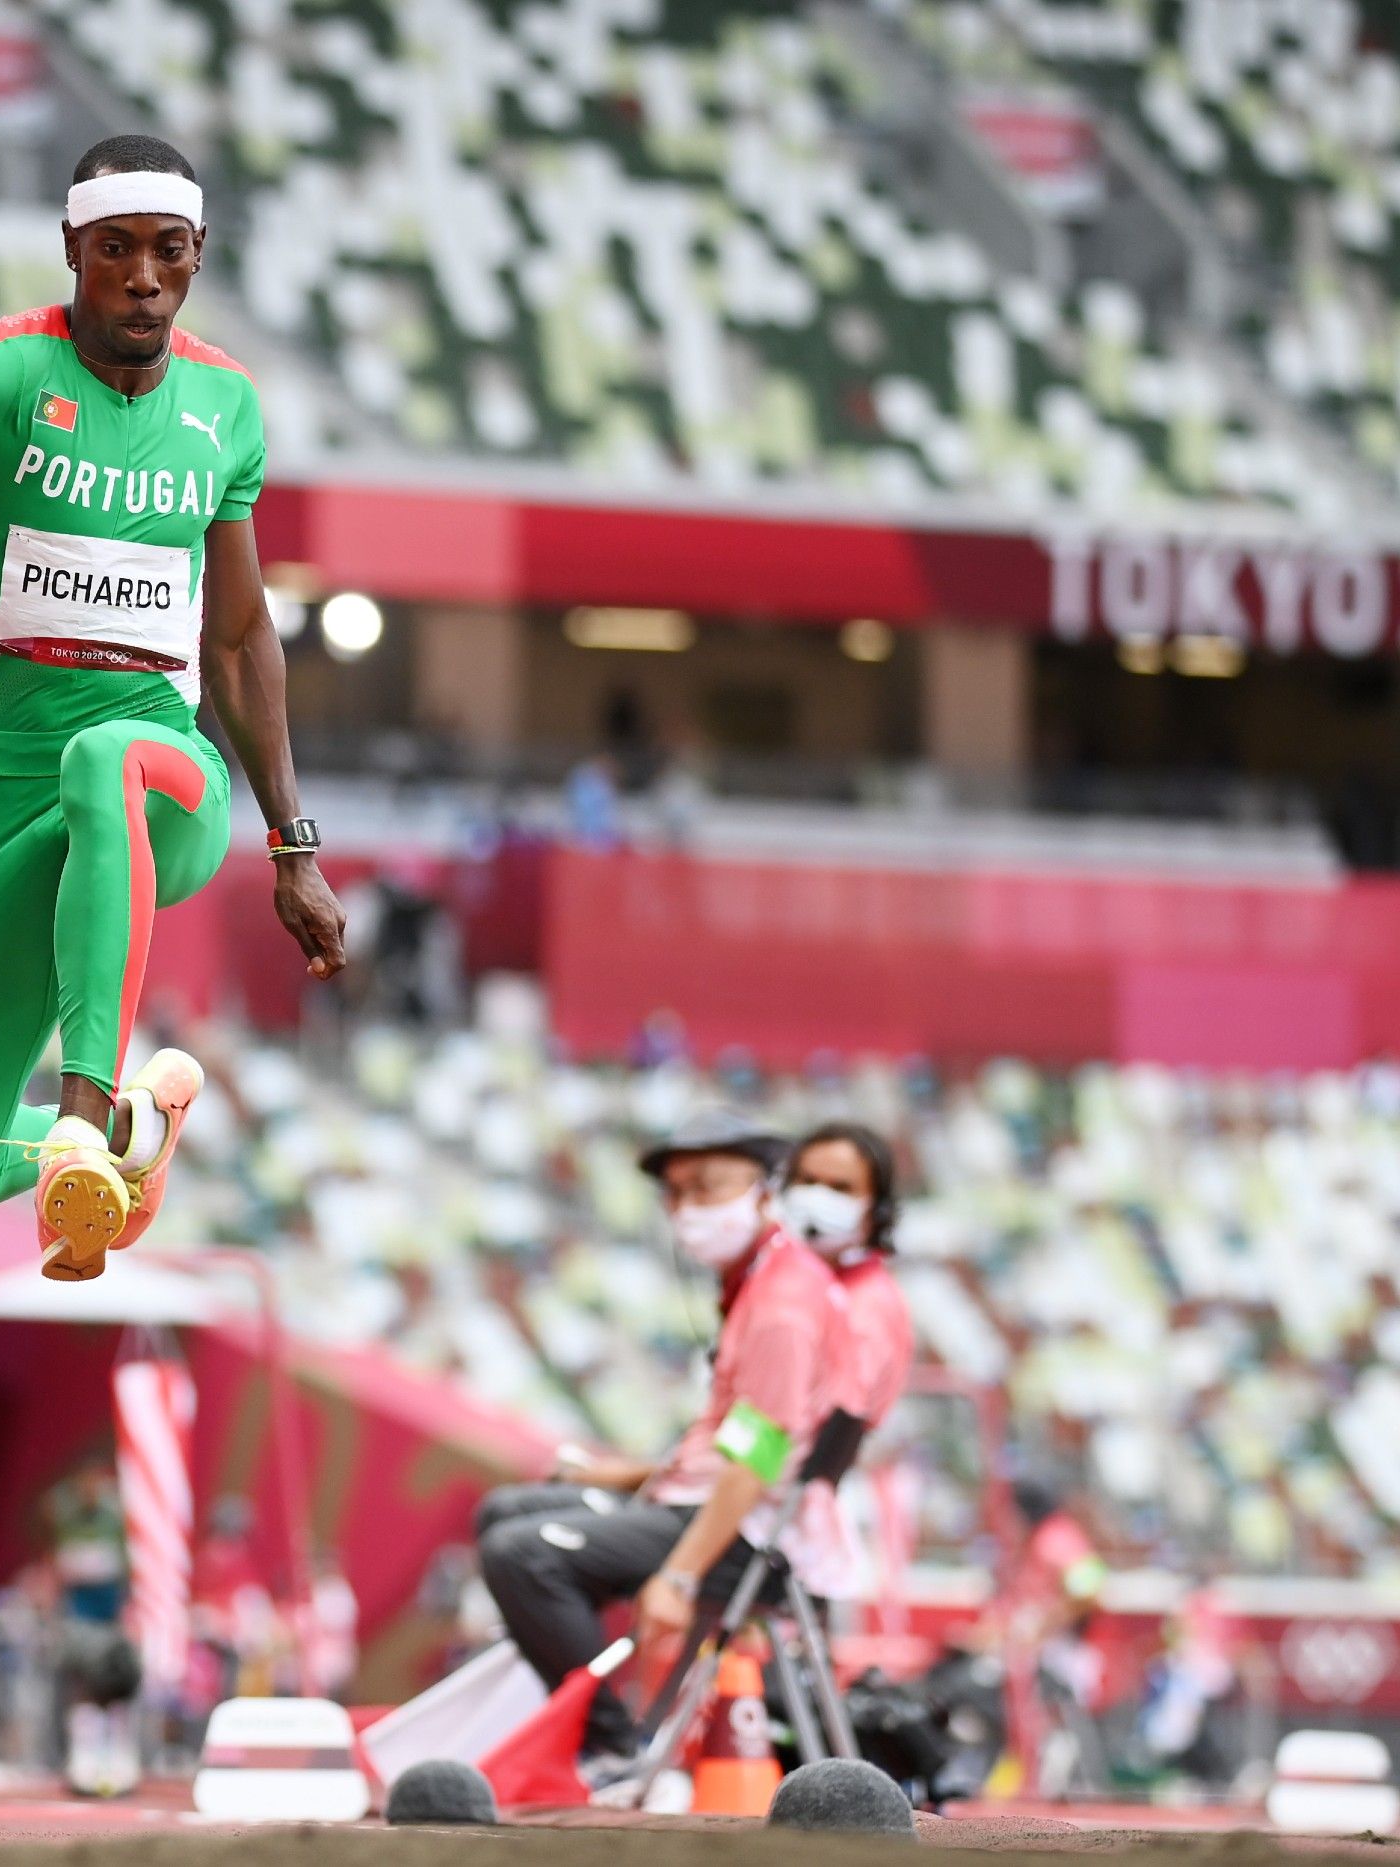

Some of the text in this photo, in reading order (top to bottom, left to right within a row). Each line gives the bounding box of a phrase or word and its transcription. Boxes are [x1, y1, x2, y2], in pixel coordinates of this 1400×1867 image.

[13, 443, 216, 516] PORTUGAL
[21, 563, 172, 610] PICHARDO
[1034, 518, 1389, 660] TOKYO
[50, 647, 103, 660] TOKYO 2020
